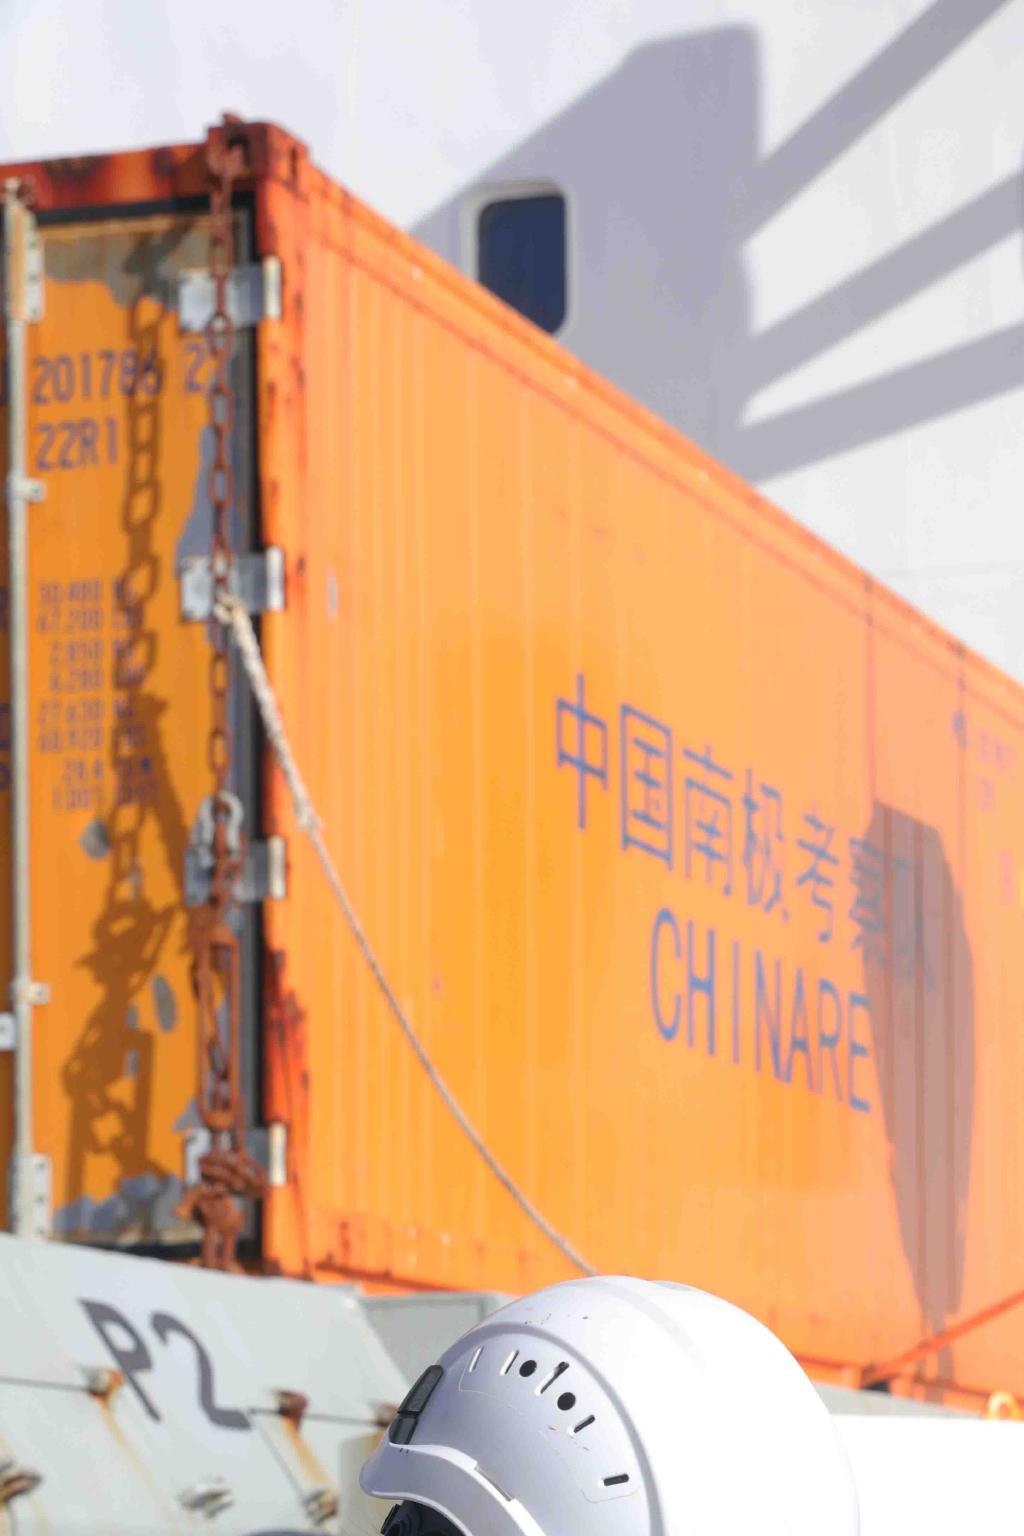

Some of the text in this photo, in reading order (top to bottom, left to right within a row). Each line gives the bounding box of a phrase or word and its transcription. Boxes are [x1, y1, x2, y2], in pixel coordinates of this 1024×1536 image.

[36, 416, 119, 472] 22R1
[650, 906, 872, 1112] CHINARE
[79, 1298, 252, 1431] P2
